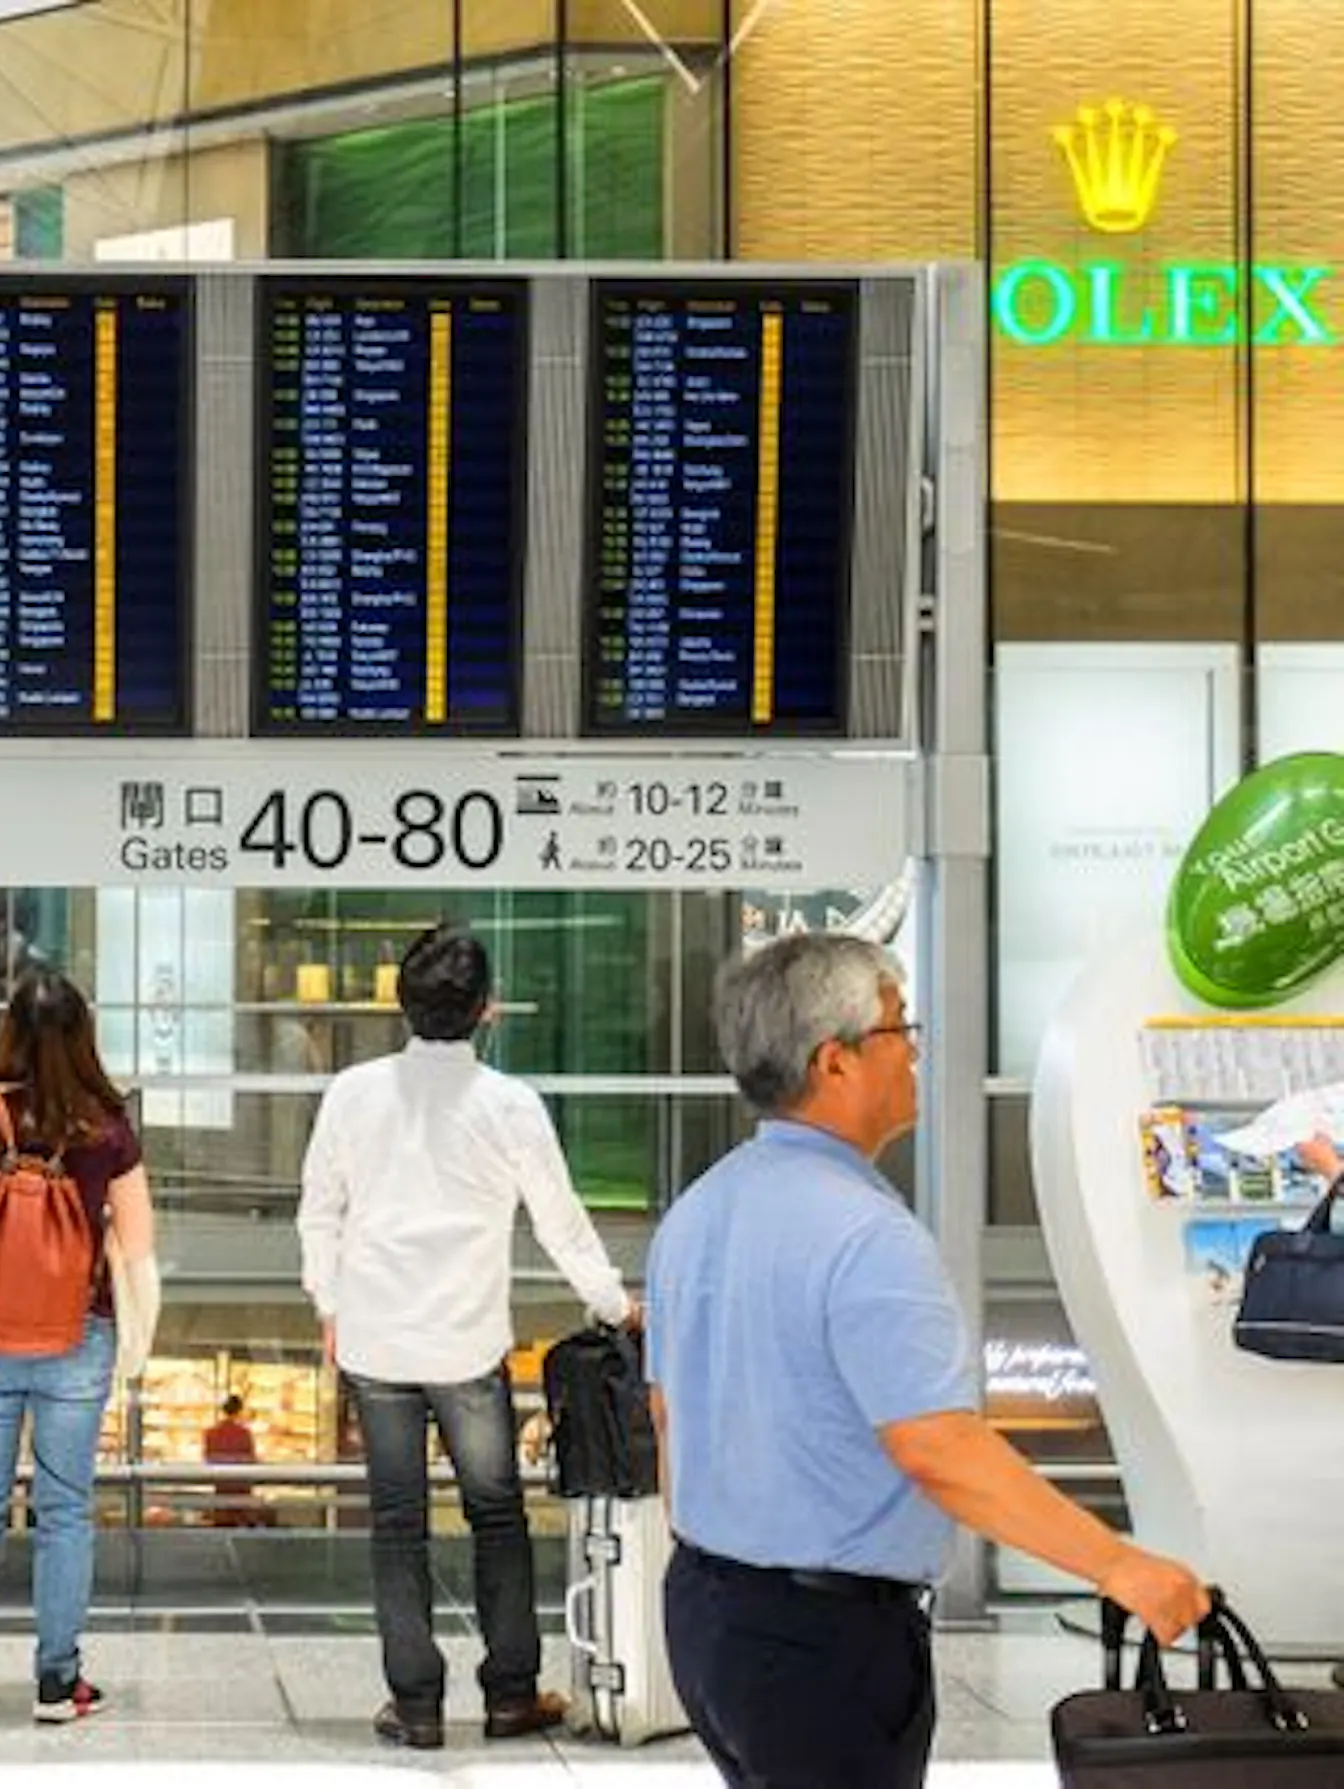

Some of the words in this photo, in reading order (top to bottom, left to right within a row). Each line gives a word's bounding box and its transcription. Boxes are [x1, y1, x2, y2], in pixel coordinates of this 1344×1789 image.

[992, 258, 1336, 346] OLEX
[628, 781, 728, 816] 10-12
[120, 837, 229, 871] Gates
[239, 789, 504, 871] 40-80
[625, 837, 732, 872] 20-25
[1221, 829, 1326, 891] Airport
